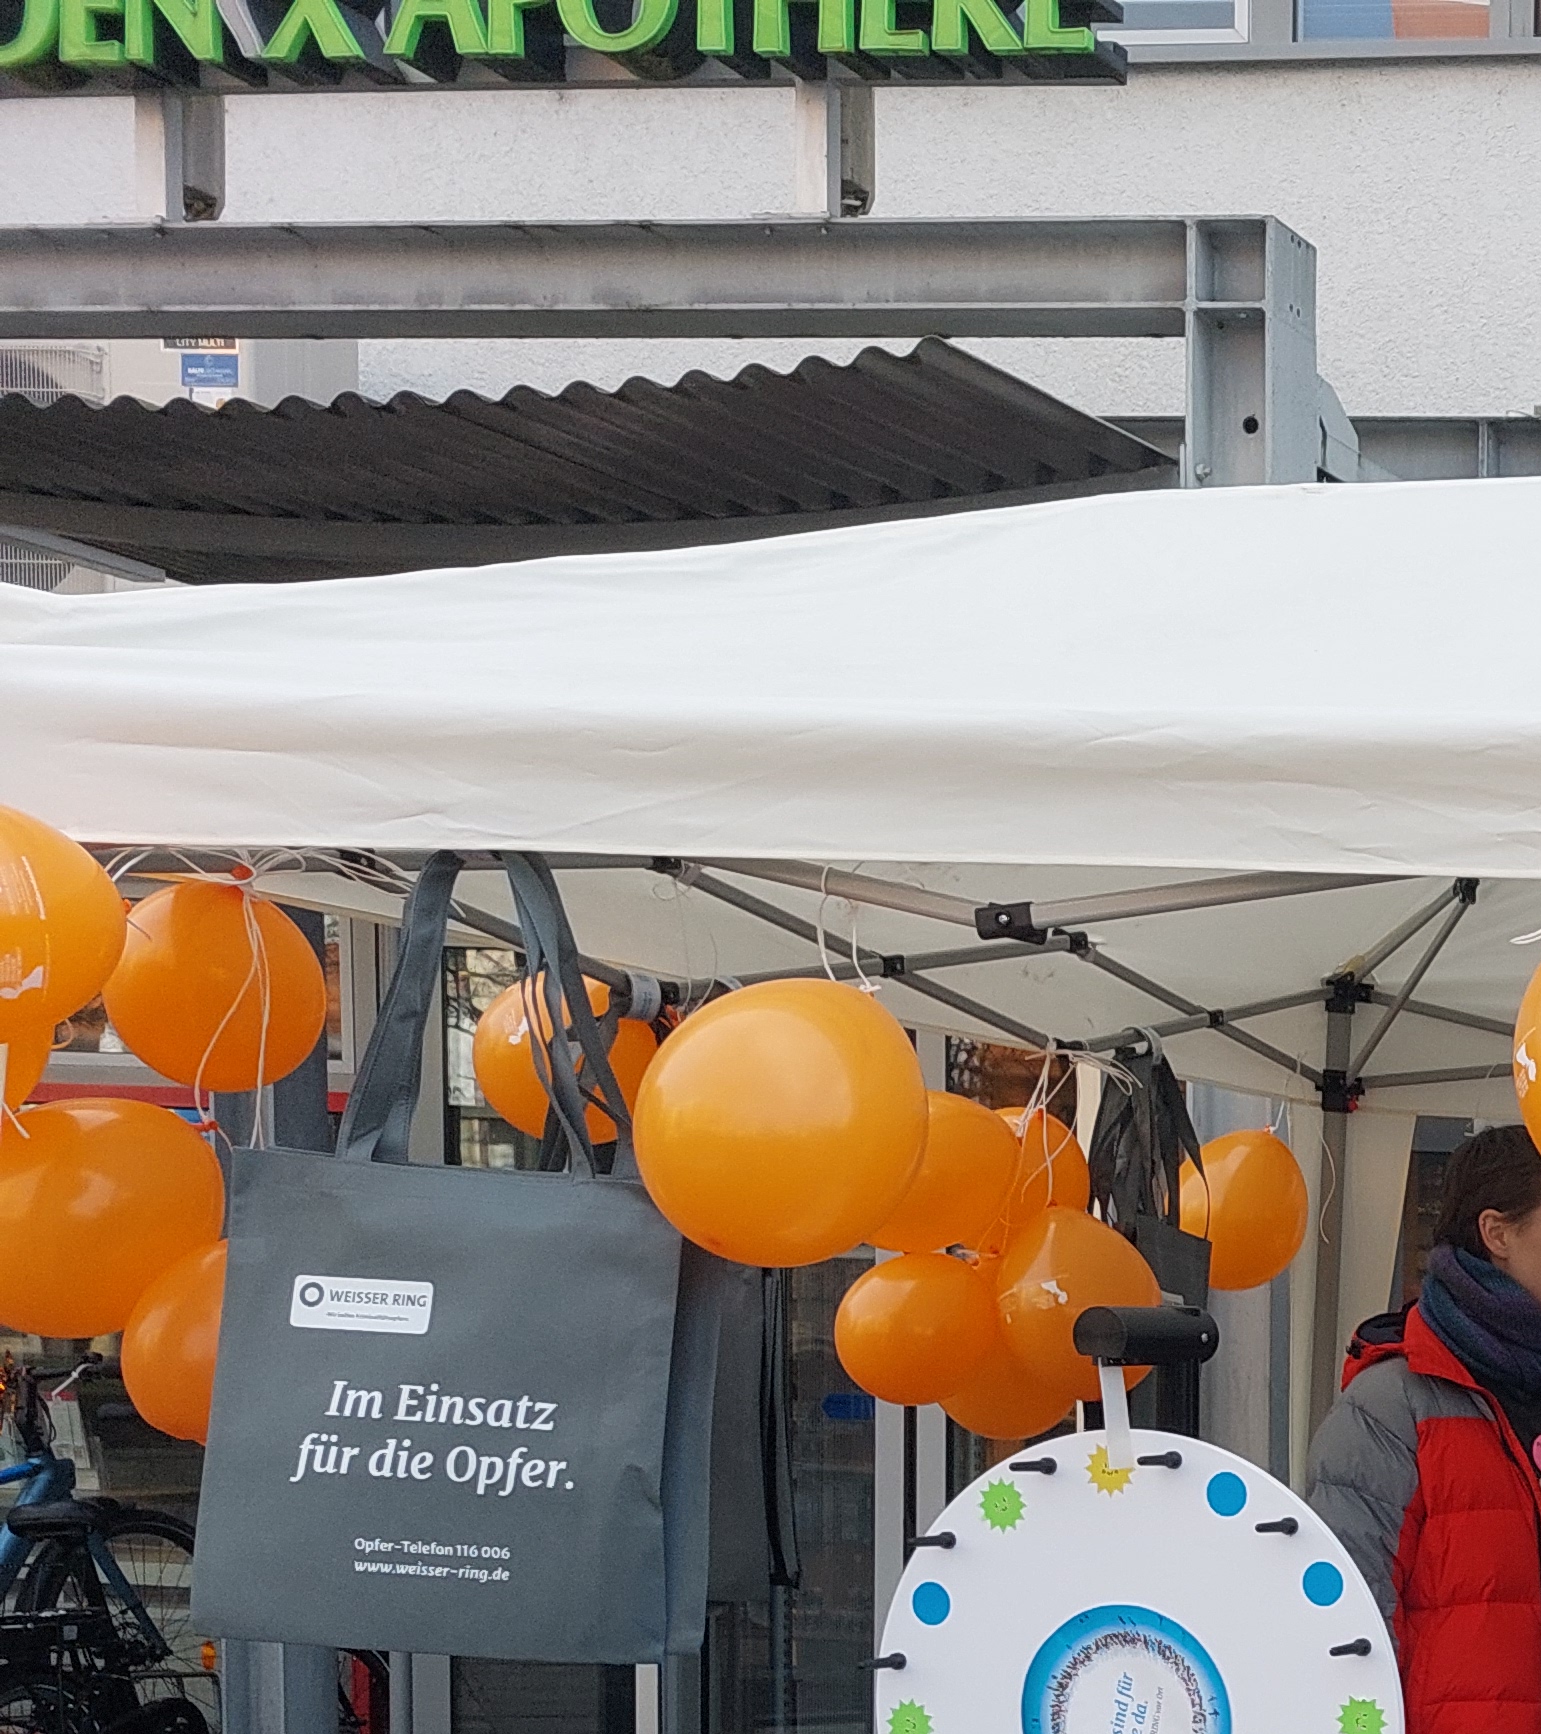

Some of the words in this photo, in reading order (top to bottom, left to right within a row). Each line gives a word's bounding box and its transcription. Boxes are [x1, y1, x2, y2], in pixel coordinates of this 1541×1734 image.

[329, 1289, 389, 1306] WEISSER
[392, 1293, 428, 1308] RING
[324, 1381, 383, 1419] Im
[393, 1383, 558, 1431] Einsatz
[289, 1432, 360, 1482] für
[369, 1438, 433, 1480] die
[446, 1445, 574, 1496] Opfer.
[354, 1538, 453, 1556] Opfer-Telefon
[455, 1544, 478, 1558] 116
[481, 1546, 511, 1560] 006
[354, 1560, 510, 1583] www.weisser-ring.de
[1115, 1672, 1135, 1702] für
[1131, 1701, 1149, 1723] da.
